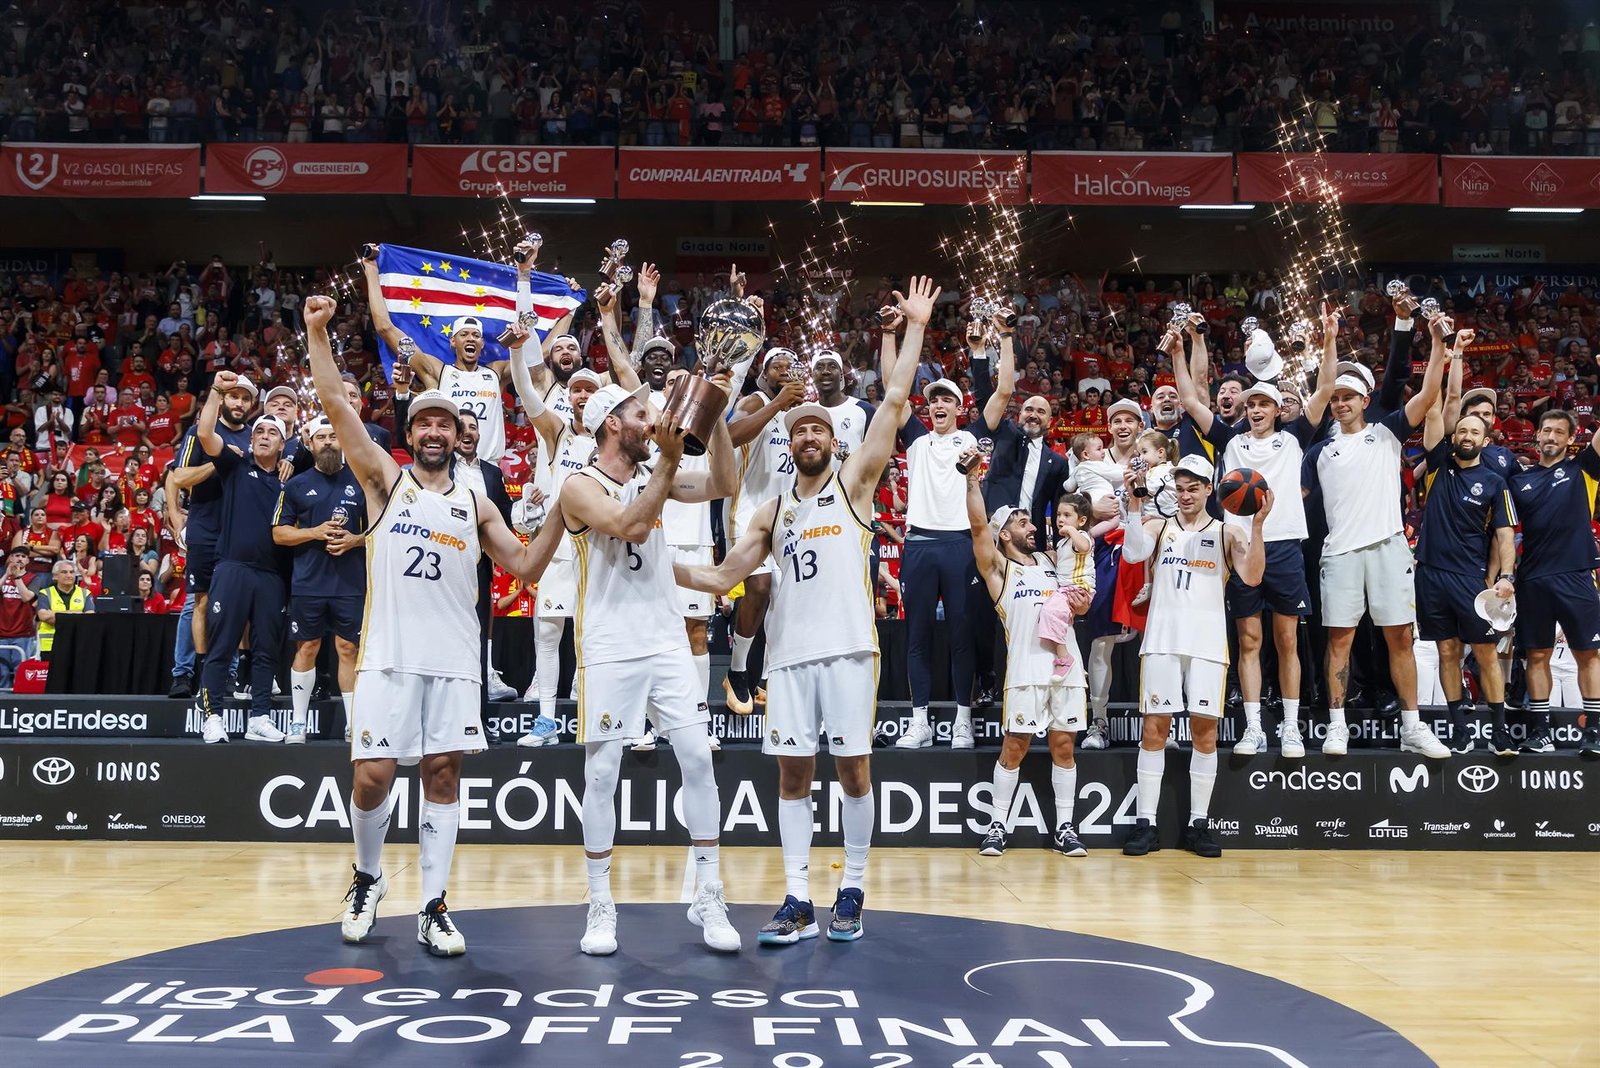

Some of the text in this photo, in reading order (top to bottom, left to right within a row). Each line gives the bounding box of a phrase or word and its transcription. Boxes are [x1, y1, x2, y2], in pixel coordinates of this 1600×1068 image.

[63, 163, 184, 176] V2 GASOLINERAS
[299, 161, 361, 174] INGENIERÍA
[481, 150, 567, 173] caser
[628, 168, 783, 183] COMPRALAENTRADA
[863, 169, 1020, 189] GRUPOSURESTE
[459, 180, 567, 195] Grupo Helvetia
[681, 241, 765, 252] Grada Norte
[1504, 247, 1542, 258] Norte
[1495, 274, 1600, 288] UNERSIDA
[451, 390, 497, 398] AUTOHERO
[777, 453, 795, 475] 28
[389, 522, 467, 551] AUTOHERO
[783, 524, 842, 557] AUHERO
[403, 546, 442, 581] 23
[792, 549, 818, 582] 13
[1162, 557, 1217, 570] AUTOHERO
[1176, 569, 1192, 590] 11
[0, 707, 148, 734] LigaEndesa
[222, 708, 245, 733] ADA
[1548, 724, 1583, 742] cb
[97, 761, 161, 782] IONOS
[1249, 765, 1362, 791] endesa
[1521, 769, 1584, 790] IONOS
[259, 761, 584, 830] CAMEÓN
[0, 814, 35, 823] ransaher
[161, 815, 206, 824] ONEBOX
[1315, 817, 1346, 831] renfe
[1255, 824, 1299, 836] SPALDING
[1369, 828, 1409, 838] LOTUS
[101, 980, 861, 1010] liga endesa
[37, 1013, 1171, 1047] PLAYOFF FINAL
